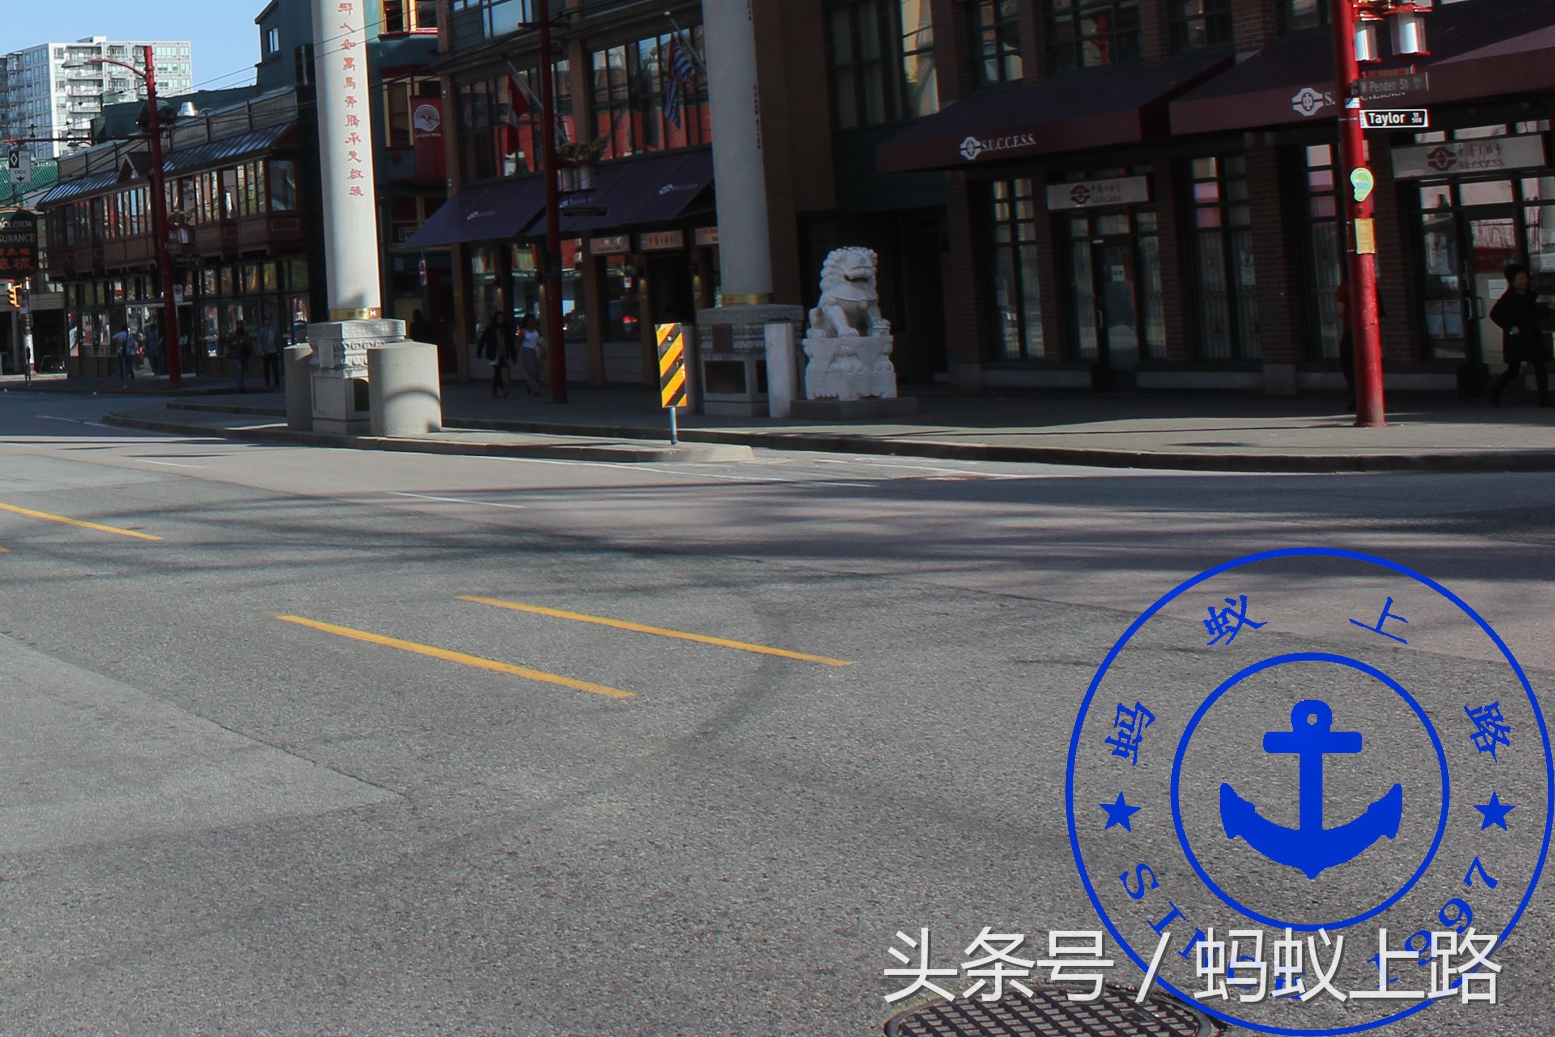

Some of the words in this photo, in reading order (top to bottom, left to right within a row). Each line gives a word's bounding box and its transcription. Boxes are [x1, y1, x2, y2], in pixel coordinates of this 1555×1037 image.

[1370, 79, 1396, 92] Pender
[1399, 78, 1408, 90] St
[1368, 112, 1406, 126] Taylor
[12, 219, 34, 228] CHOW
